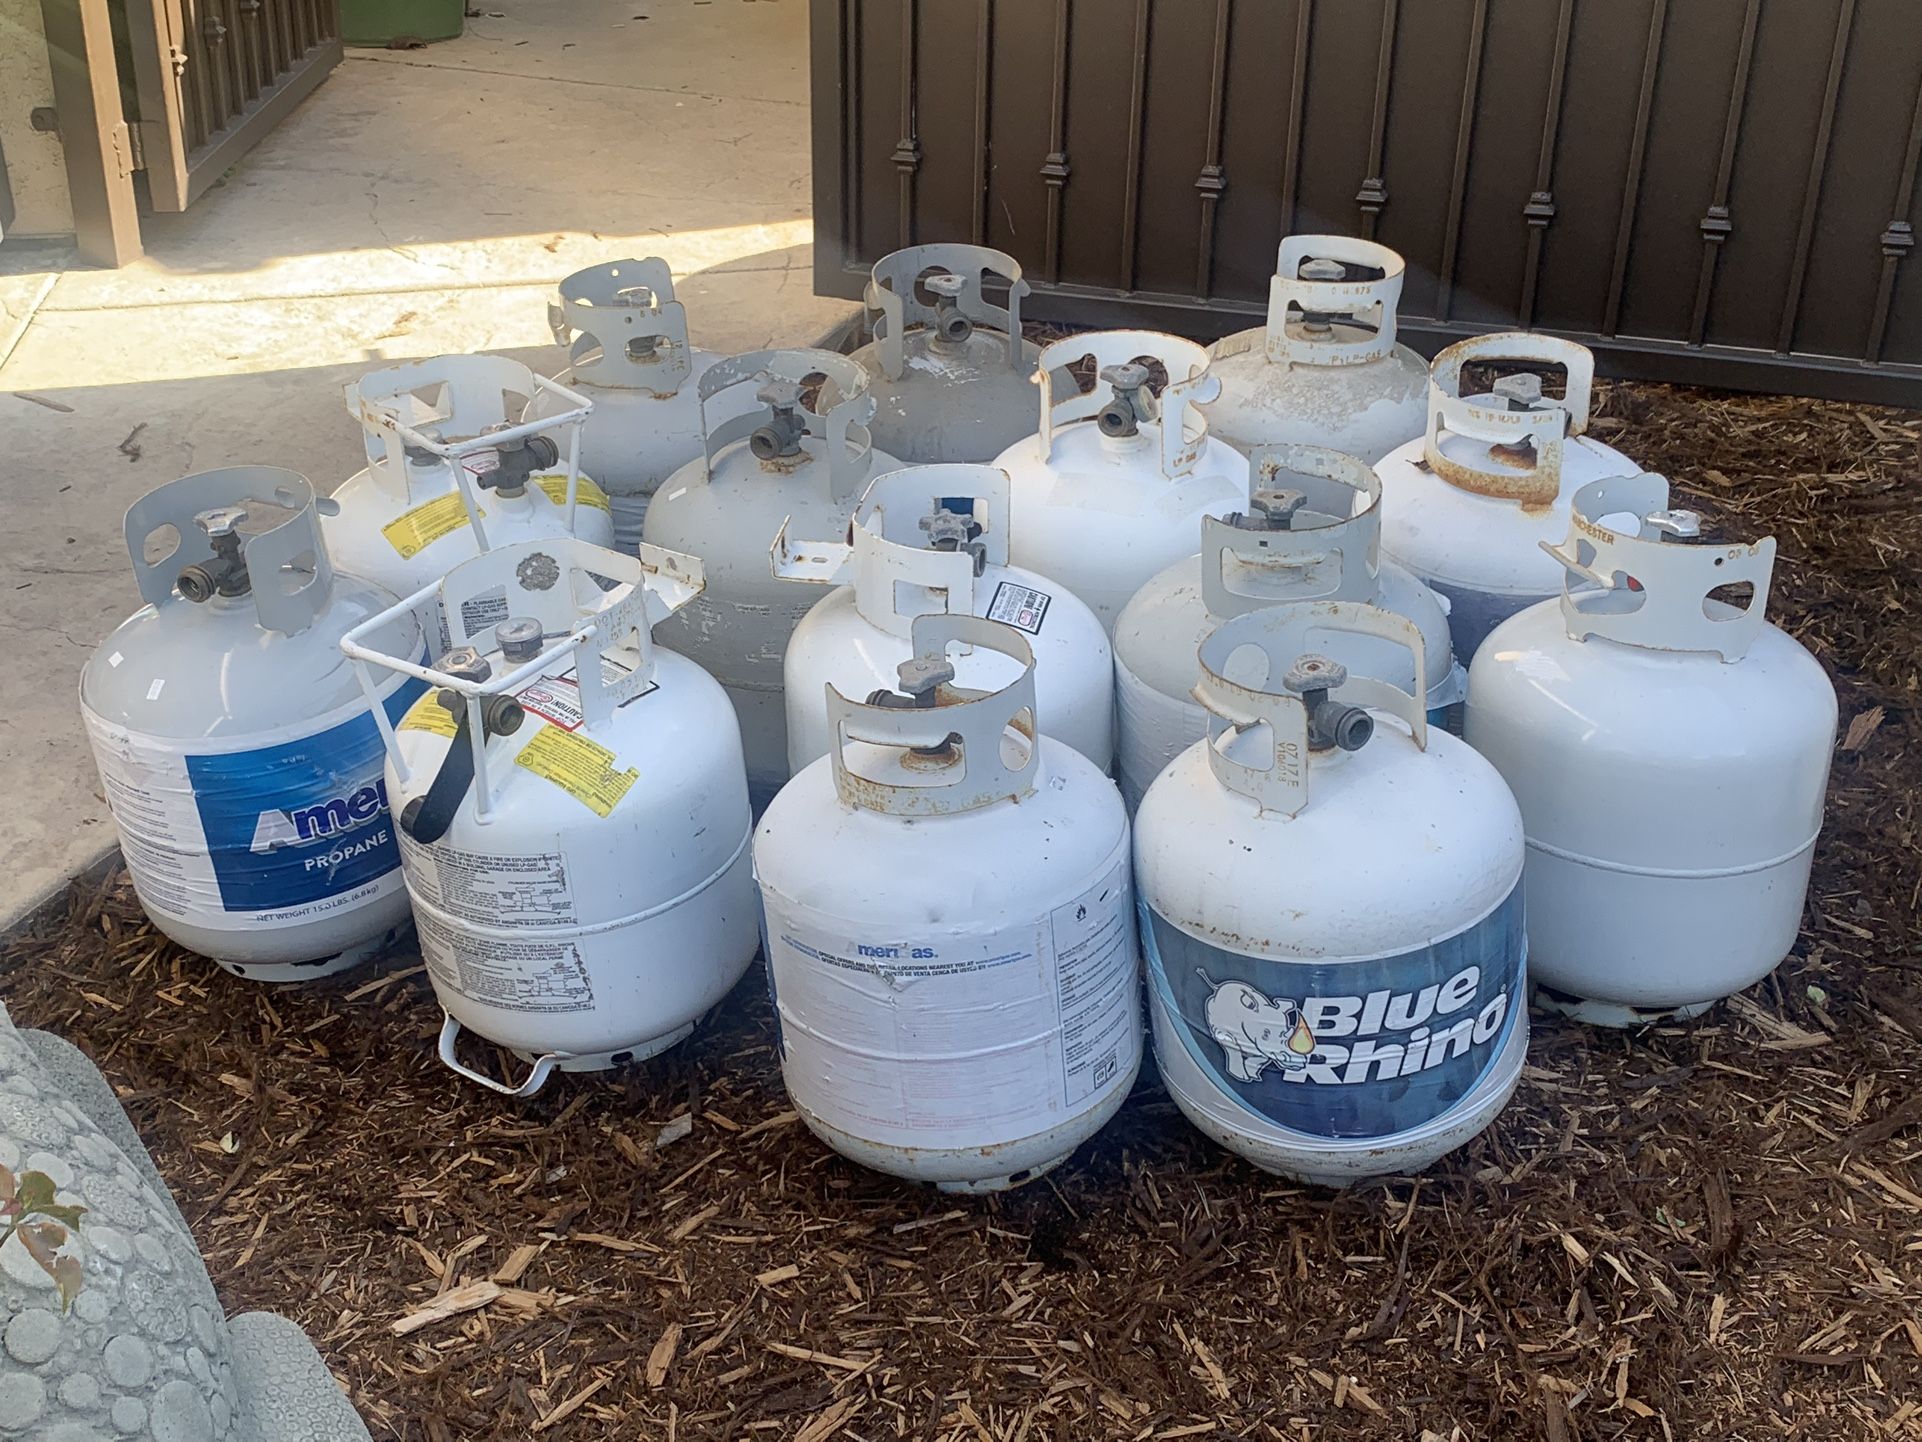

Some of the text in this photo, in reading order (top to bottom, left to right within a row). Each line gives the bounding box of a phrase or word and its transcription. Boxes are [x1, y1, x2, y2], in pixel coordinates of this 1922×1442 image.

[304, 829, 389, 871] PROPANE
[275, 908, 311, 920] WEIGHT
[1300, 965, 1481, 1037] Blue
[1283, 992, 1508, 1085] Rhino
